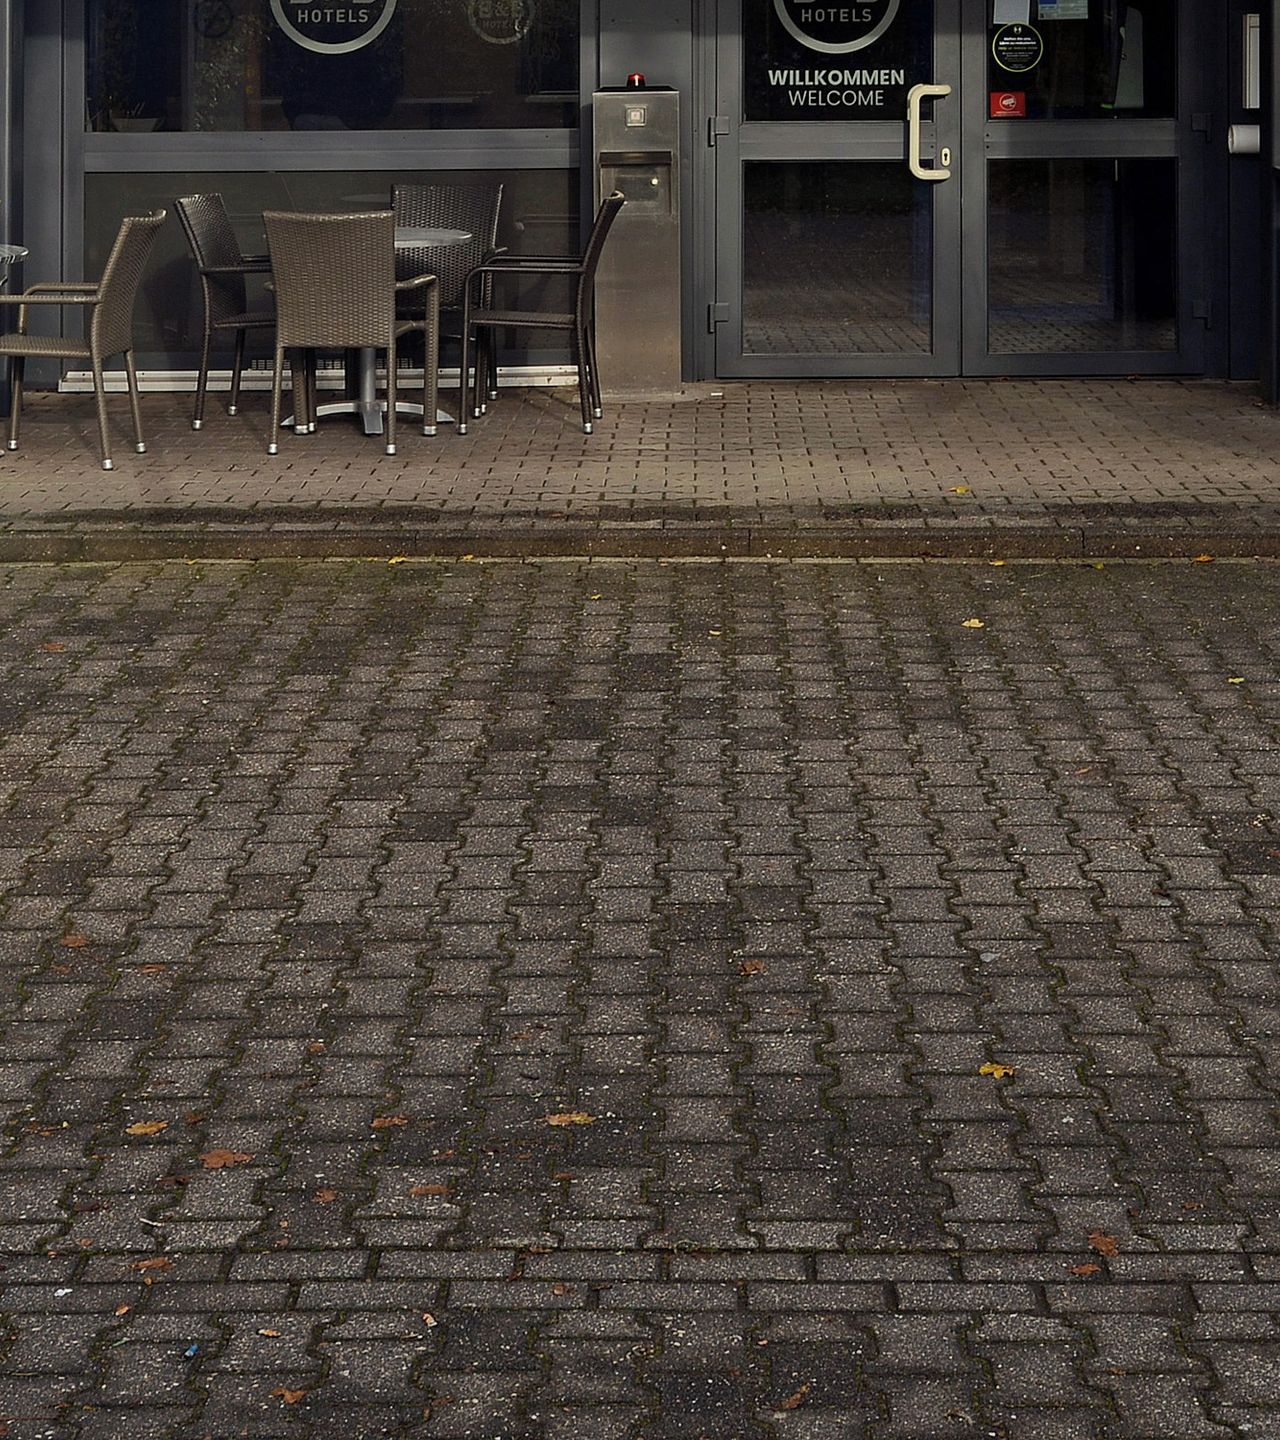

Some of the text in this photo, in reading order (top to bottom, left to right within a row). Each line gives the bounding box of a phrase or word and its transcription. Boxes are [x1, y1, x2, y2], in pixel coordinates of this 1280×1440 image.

[297, 9, 370, 23] HOTELS
[801, 9, 872, 23] HOTELS
[768, 69, 905, 86] WILLKOMMEN
[788, 89, 885, 106] WELCOME
